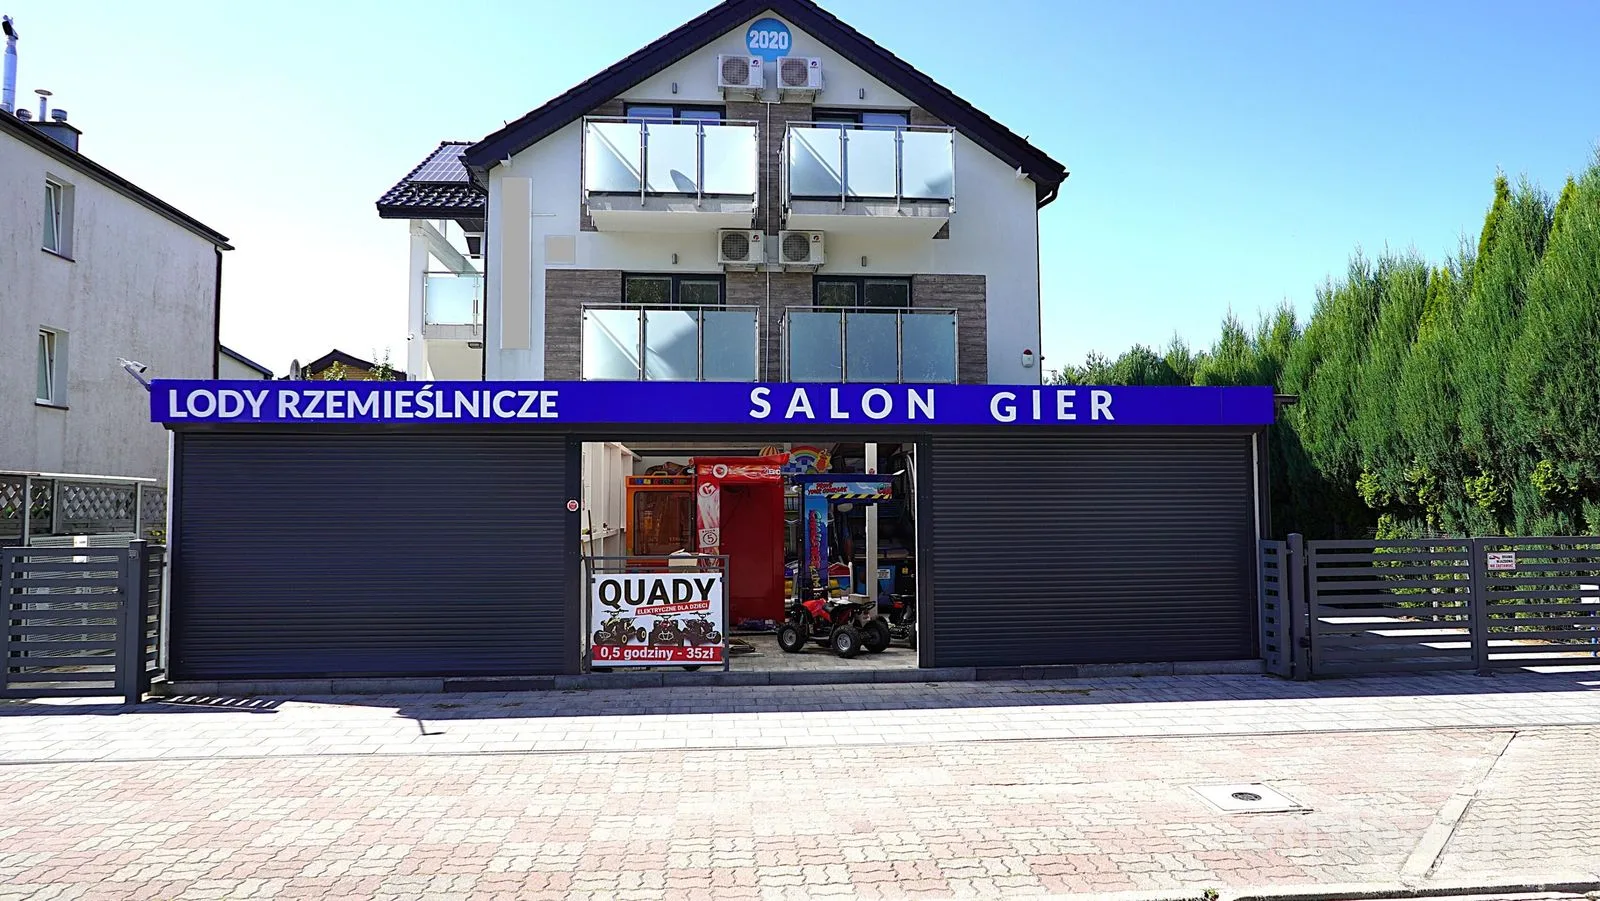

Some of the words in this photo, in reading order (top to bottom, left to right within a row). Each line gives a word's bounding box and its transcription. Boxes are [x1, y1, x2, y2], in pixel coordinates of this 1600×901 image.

[749, 30, 789, 50] 2020
[169, 389, 270, 418] LODY
[278, 384, 559, 419] RZEMIEŚLNICZE
[749, 386, 935, 420] SALON
[989, 389, 1115, 422] GIER
[598, 578, 716, 609] QUADY
[637, 605, 677, 615] ELEKTRYCZNE
[689, 602, 708, 610] DZIECI
[600, 646, 620, 660] 0,5
[623, 646, 673, 661] godziny
[686, 647, 714, 659] 35zł
